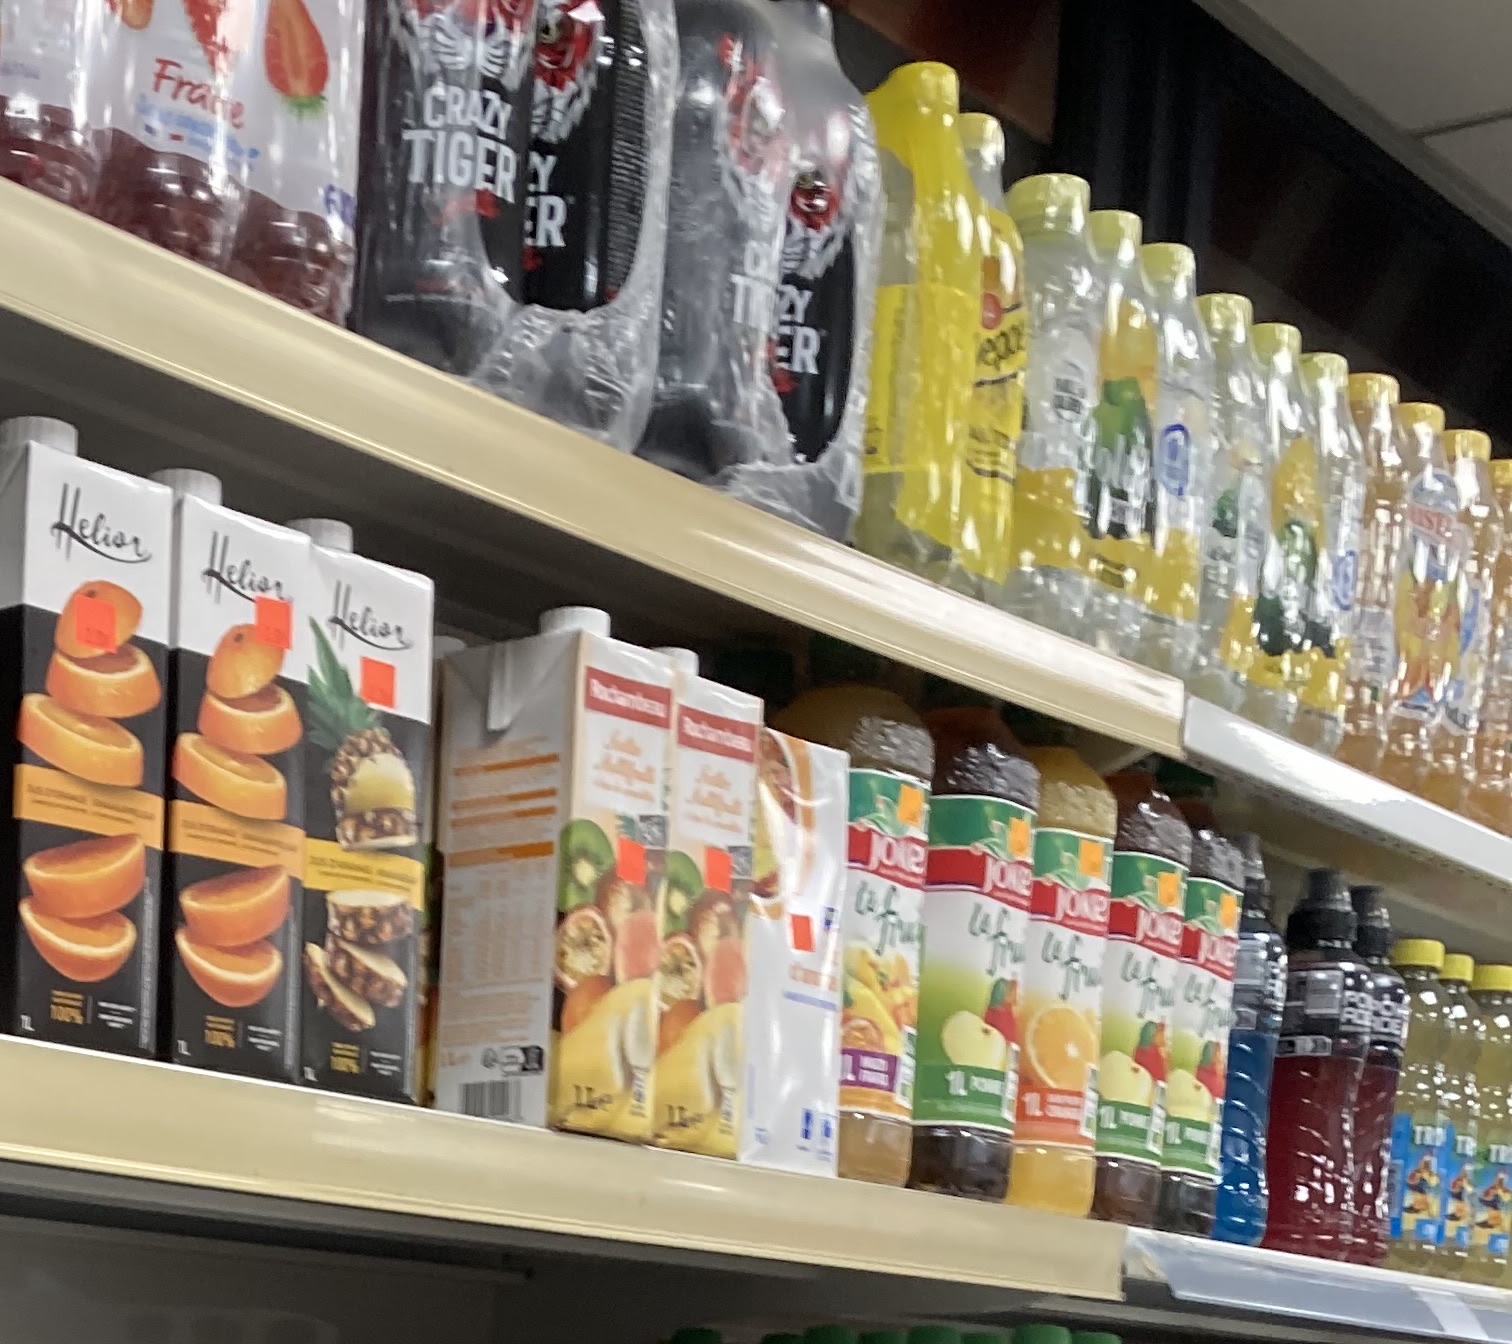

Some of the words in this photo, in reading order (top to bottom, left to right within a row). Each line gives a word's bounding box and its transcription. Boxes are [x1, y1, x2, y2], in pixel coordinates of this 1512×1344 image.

[423, 80, 514, 142] CRAZY
[401, 128, 517, 205] TIGER
[50, 481, 153, 563] Helior
[327, 580, 415, 651] Helior
